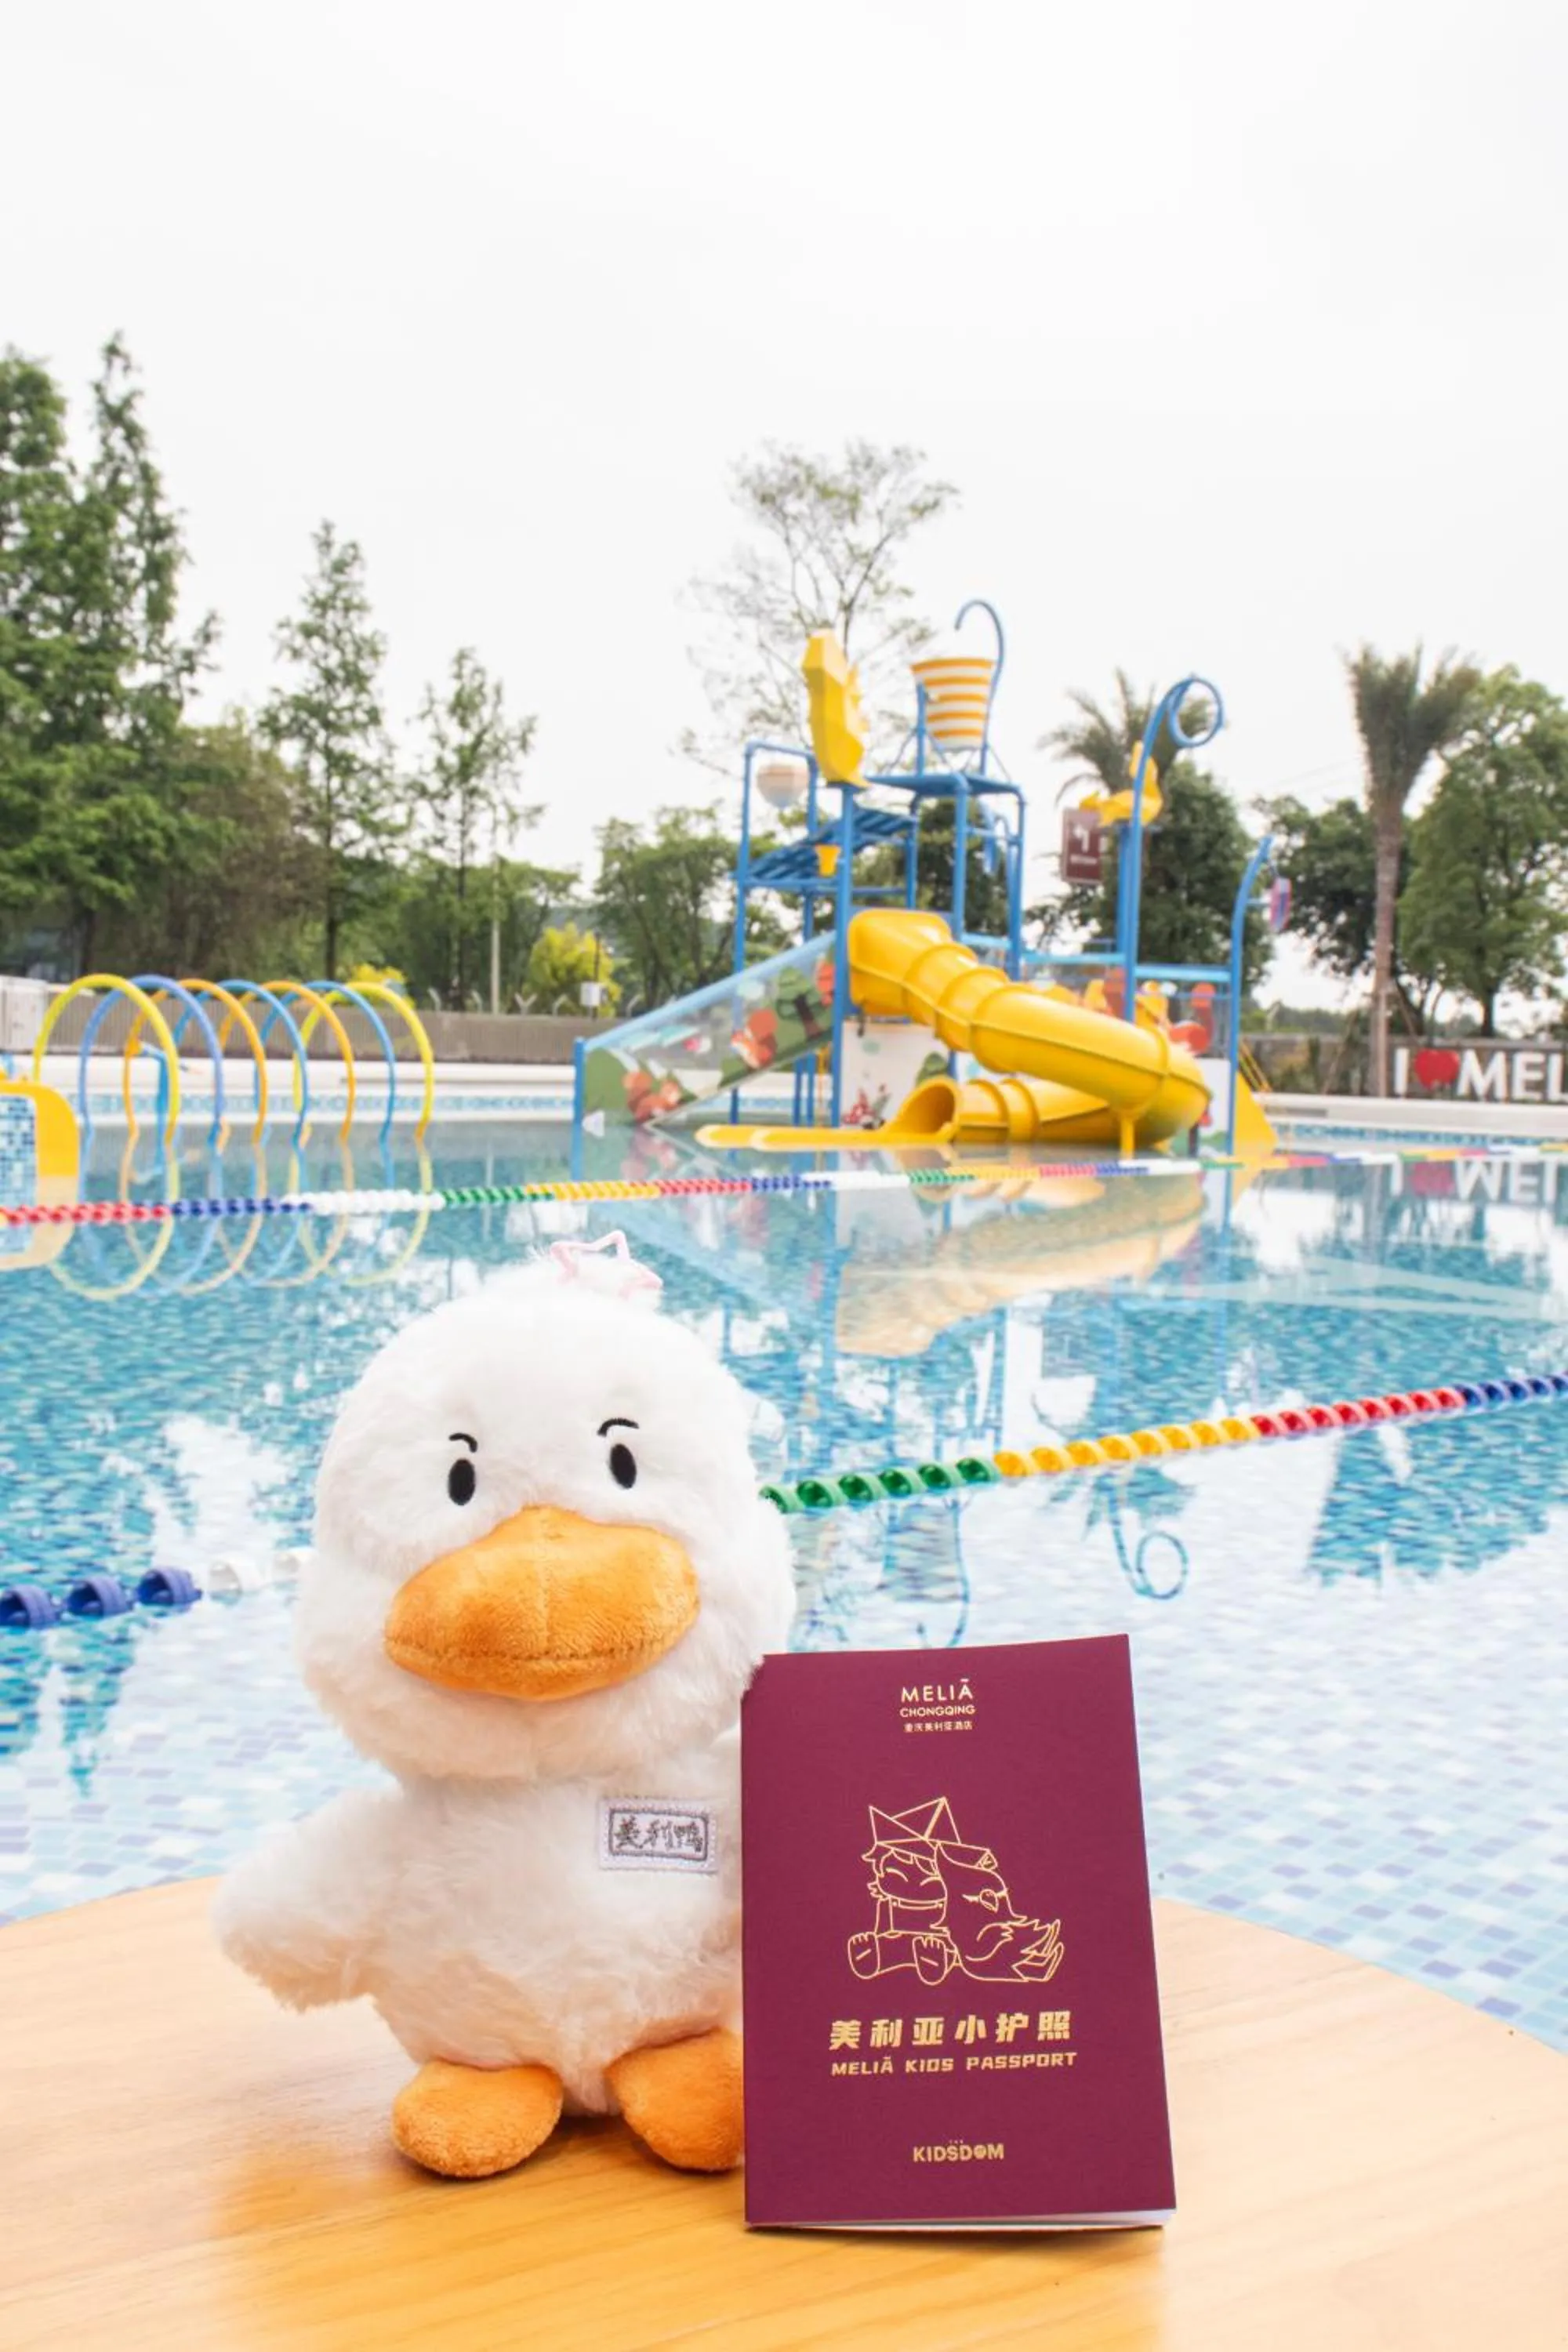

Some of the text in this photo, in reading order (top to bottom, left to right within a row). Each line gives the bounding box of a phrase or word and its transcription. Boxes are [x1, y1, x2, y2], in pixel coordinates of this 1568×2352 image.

[899, 1704, 975, 1717] CHONGQING
[829, 2010, 1071, 2050] 美利亚小护照
[905, 2058, 954, 2074] KIDS
[966, 2052, 1078, 2071] PASSPORT
